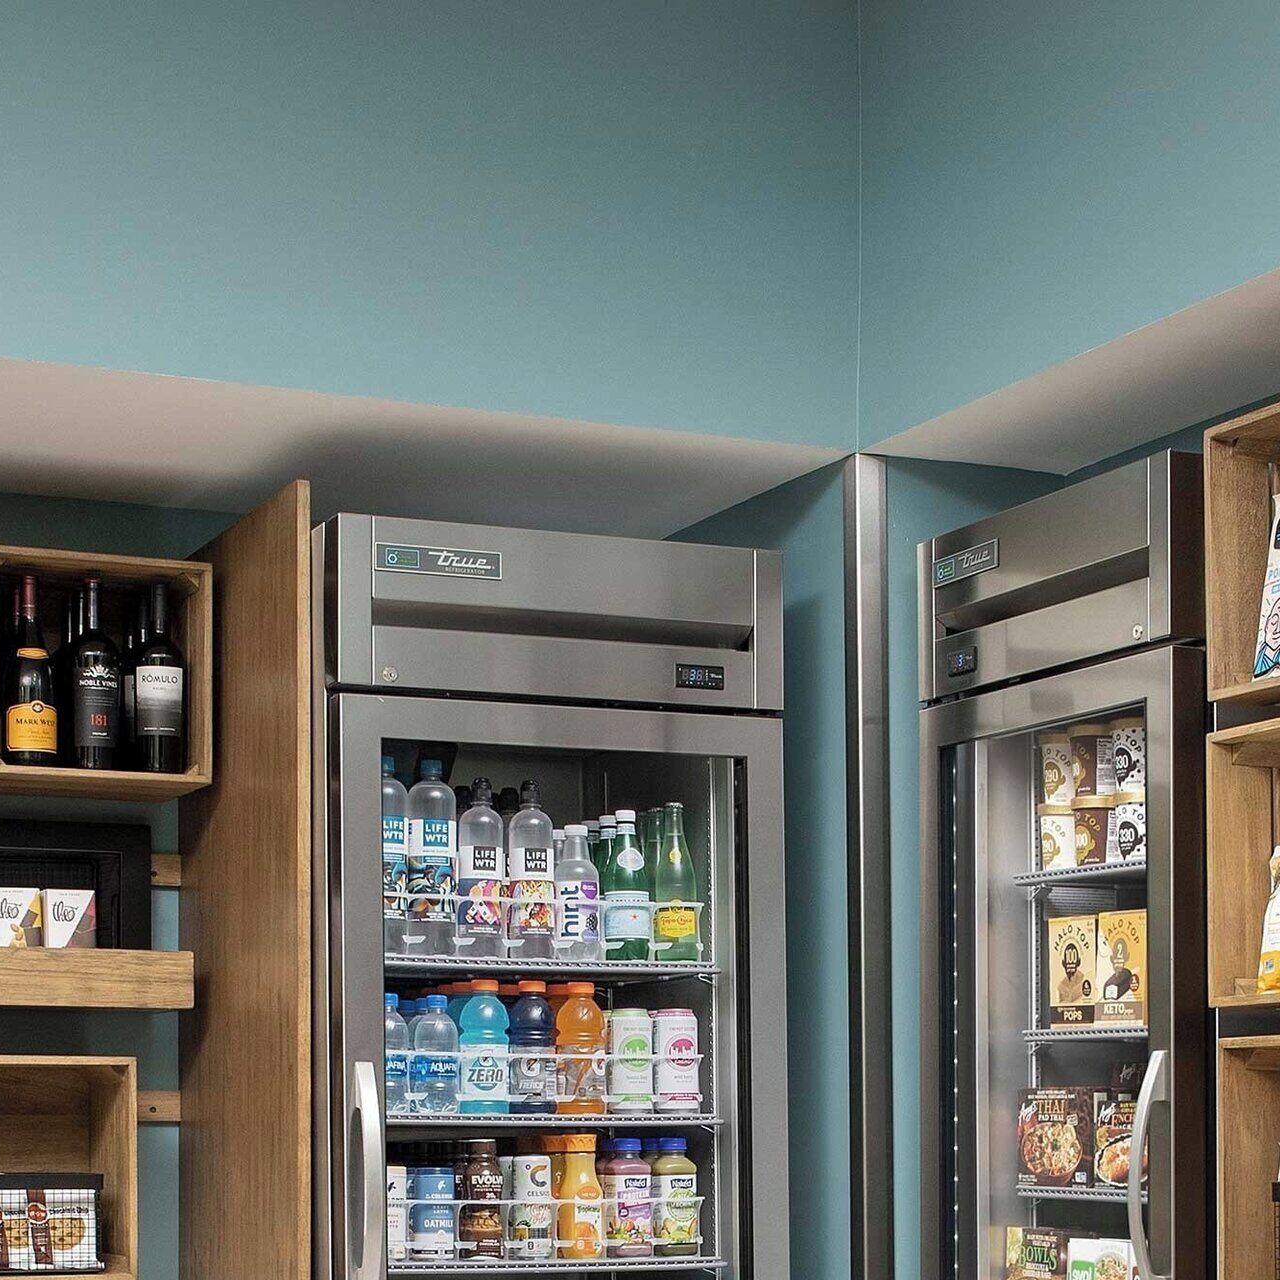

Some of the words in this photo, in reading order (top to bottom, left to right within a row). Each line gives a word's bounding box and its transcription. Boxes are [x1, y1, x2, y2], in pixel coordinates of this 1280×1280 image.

[79, 679, 101, 687] NOBLE
[15, 718, 39, 726] MARK
[90, 713, 108, 727] 181
[383, 820, 404, 831] LIFE
[424, 823, 449, 833] LIFE
[383, 830, 405, 841] WTR
[424, 833, 449, 844] WTR
[475, 849, 495, 859] LIFE
[526, 851, 546, 860] LIFE
[475, 858, 495, 869] WTR
[526, 859, 547, 870] WTR
[1054, 924, 1074, 952] HALO
[1076, 927, 1090, 950] TOP
[1103, 919, 1123, 946] HALO
[1127, 921, 1140, 944] TOP
[1103, 1003, 1125, 1014] KETO
[1063, 1010, 1083, 1021] POPS
[466, 1068, 504, 1083] ZERO
[1038, 1099, 1066, 1114] THAI
[1018, 1243, 1058, 1271] BOWLS
